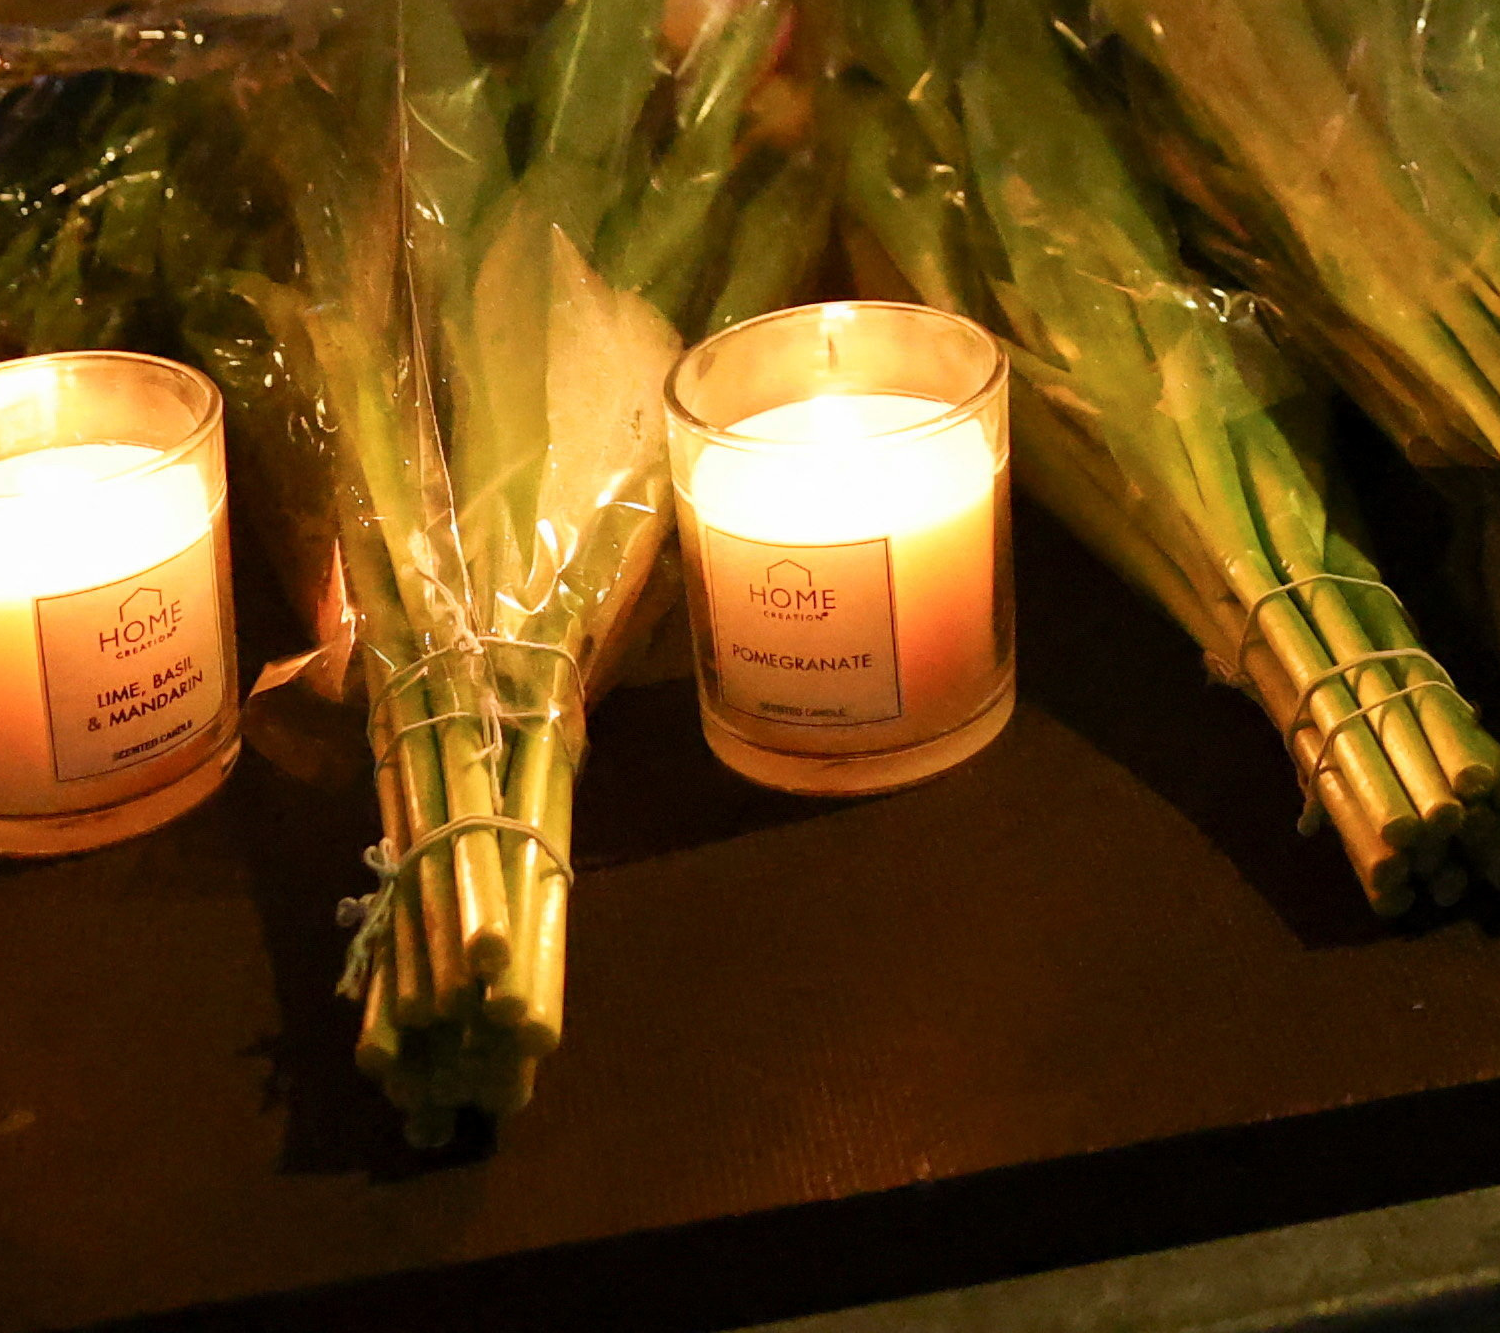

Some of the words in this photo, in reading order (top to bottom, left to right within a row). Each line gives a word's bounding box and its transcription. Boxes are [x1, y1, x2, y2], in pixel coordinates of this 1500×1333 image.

[749, 583, 836, 609] HOME
[100, 600, 183, 652] HOME
[97, 682, 146, 709] LIME,
[153, 656, 193, 688] BASIL
[732, 644, 873, 671] POMEGRANATE
[88, 715, 102, 733] &
[109, 671, 203, 727] MANDARIN
